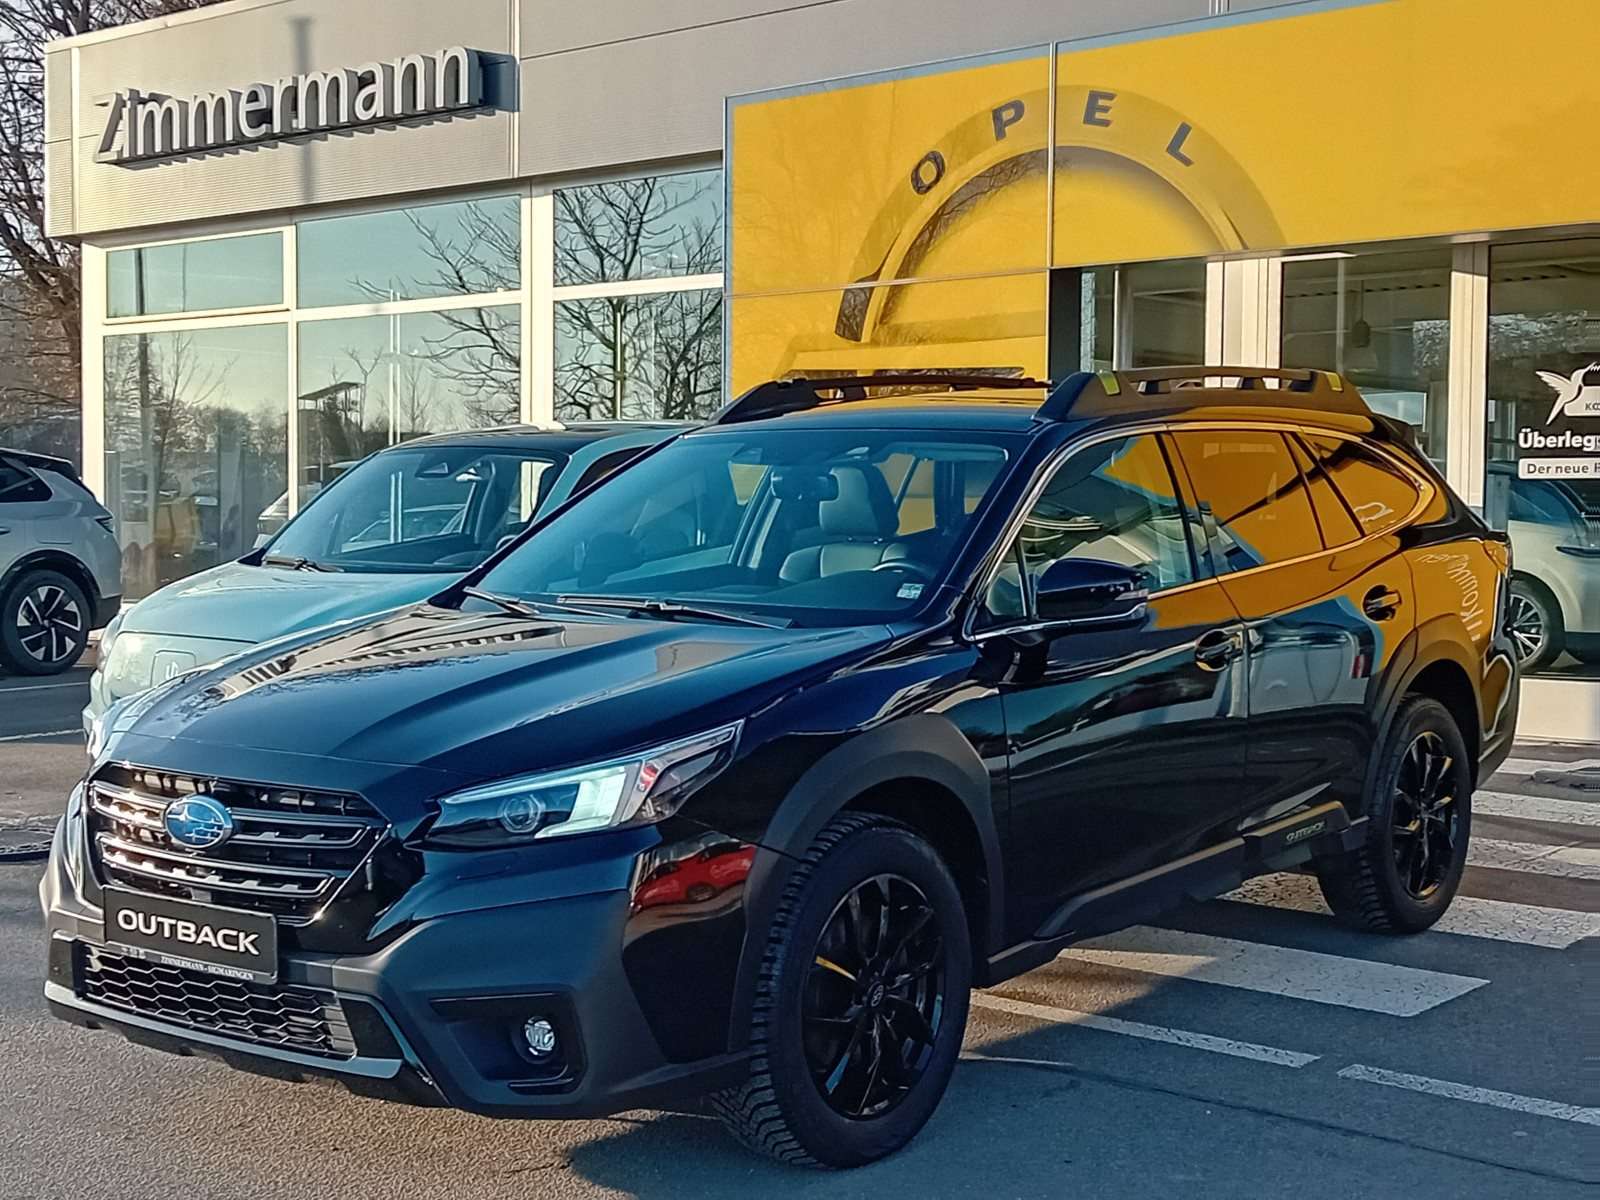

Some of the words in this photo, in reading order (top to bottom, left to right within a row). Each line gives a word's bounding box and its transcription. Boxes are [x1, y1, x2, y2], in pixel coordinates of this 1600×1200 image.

[94, 46, 469, 163] Zimmermann
[910, 89, 1195, 195] OPEL
[1527, 463, 1551, 474] Der
[1555, 465, 1589, 474] neue
[117, 909, 260, 956] OUTBACK
